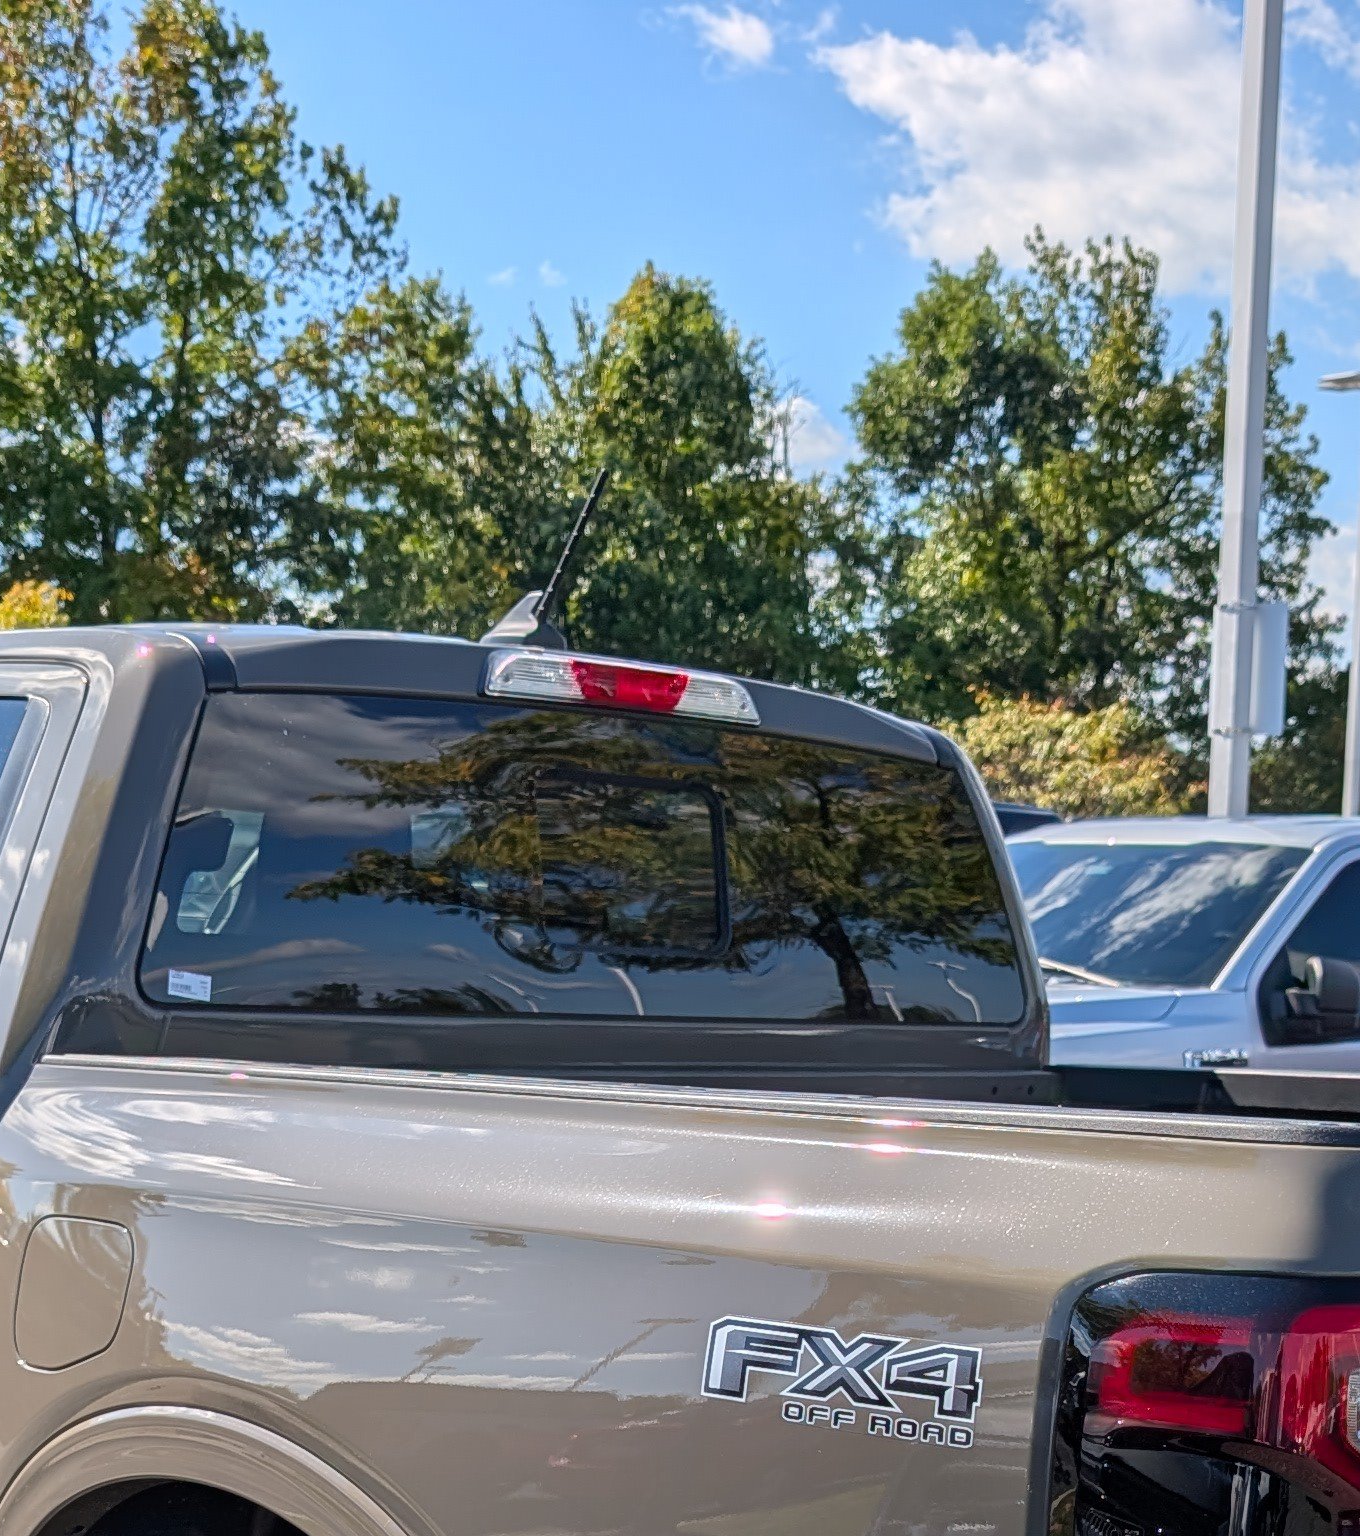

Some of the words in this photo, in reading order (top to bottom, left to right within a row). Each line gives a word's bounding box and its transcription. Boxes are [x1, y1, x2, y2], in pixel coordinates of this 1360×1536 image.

[700, 1314, 983, 1424] FX4
[782, 1400, 856, 1430] OFF
[868, 1411, 974, 1449] ROAD
